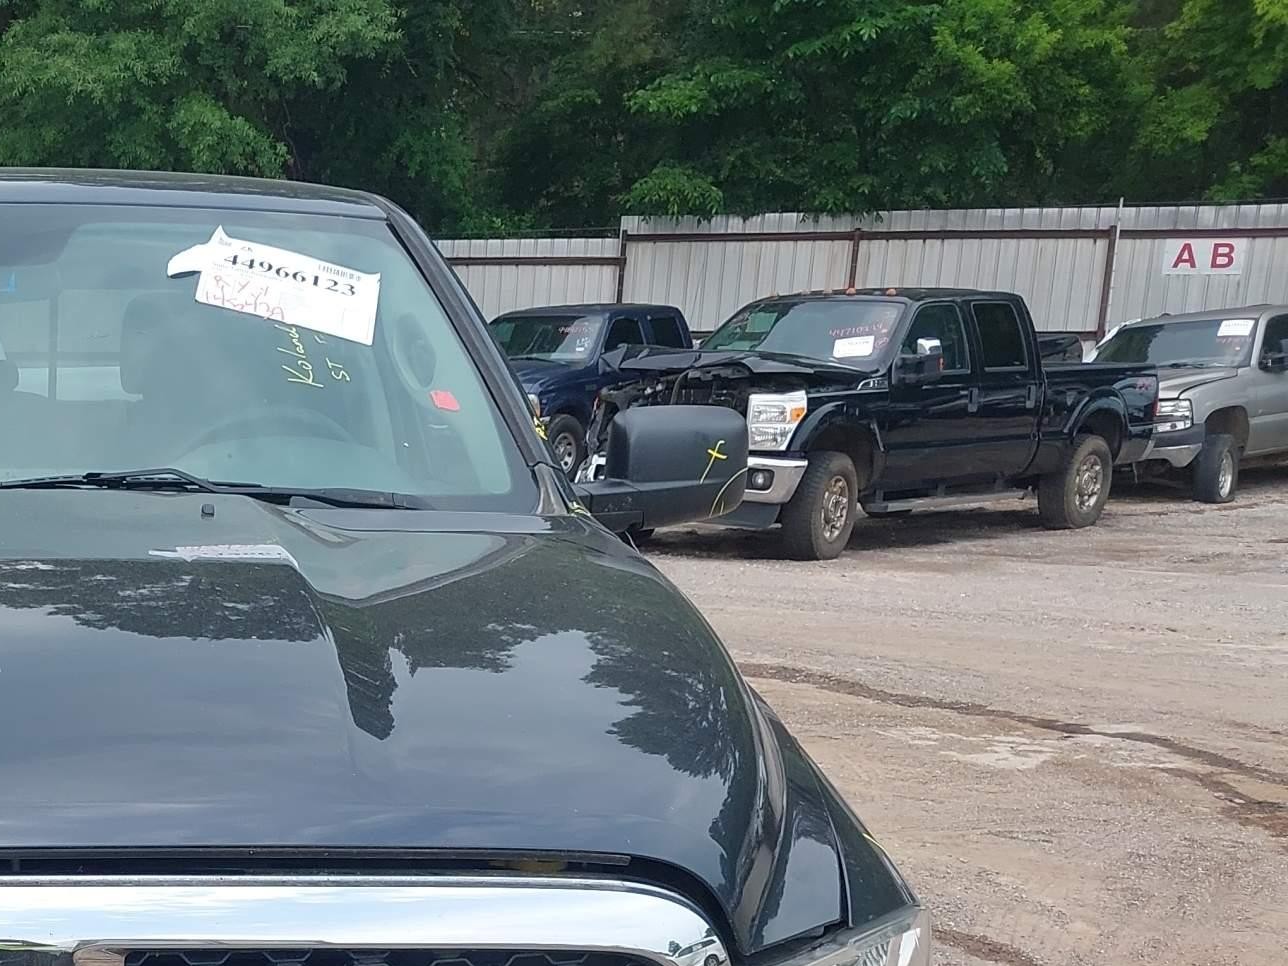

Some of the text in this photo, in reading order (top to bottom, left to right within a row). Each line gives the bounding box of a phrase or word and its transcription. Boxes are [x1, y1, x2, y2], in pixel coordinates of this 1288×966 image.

[1172, 243, 1235, 269] A B
[224, 254, 356, 297] 44966123
